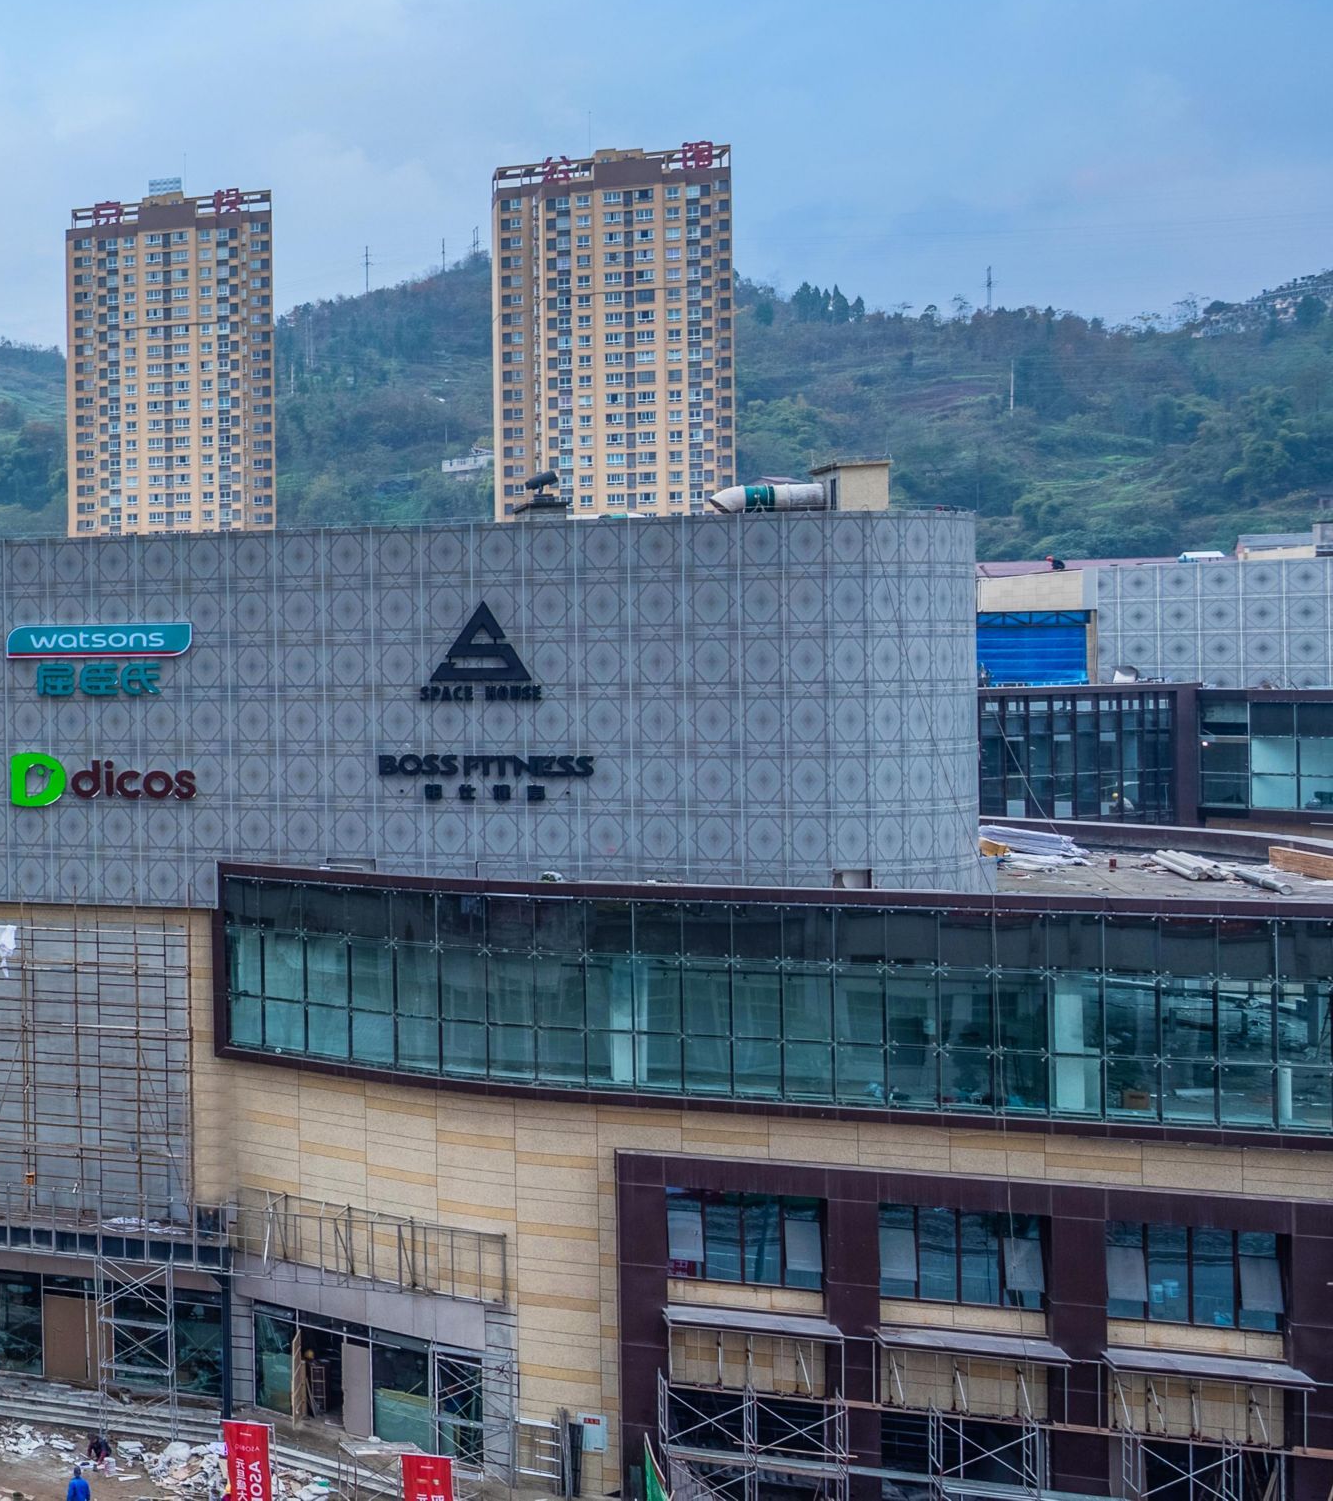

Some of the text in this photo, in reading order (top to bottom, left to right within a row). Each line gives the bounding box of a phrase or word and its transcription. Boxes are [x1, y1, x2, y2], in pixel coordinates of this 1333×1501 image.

[29, 631, 166, 649] watsons
[36, 662, 163, 697] 屈臣氏
[420, 684, 542, 702] SPACE HOUSE
[378, 754, 595, 778] BOSS FITNESS
[71, 759, 197, 800] dicos
